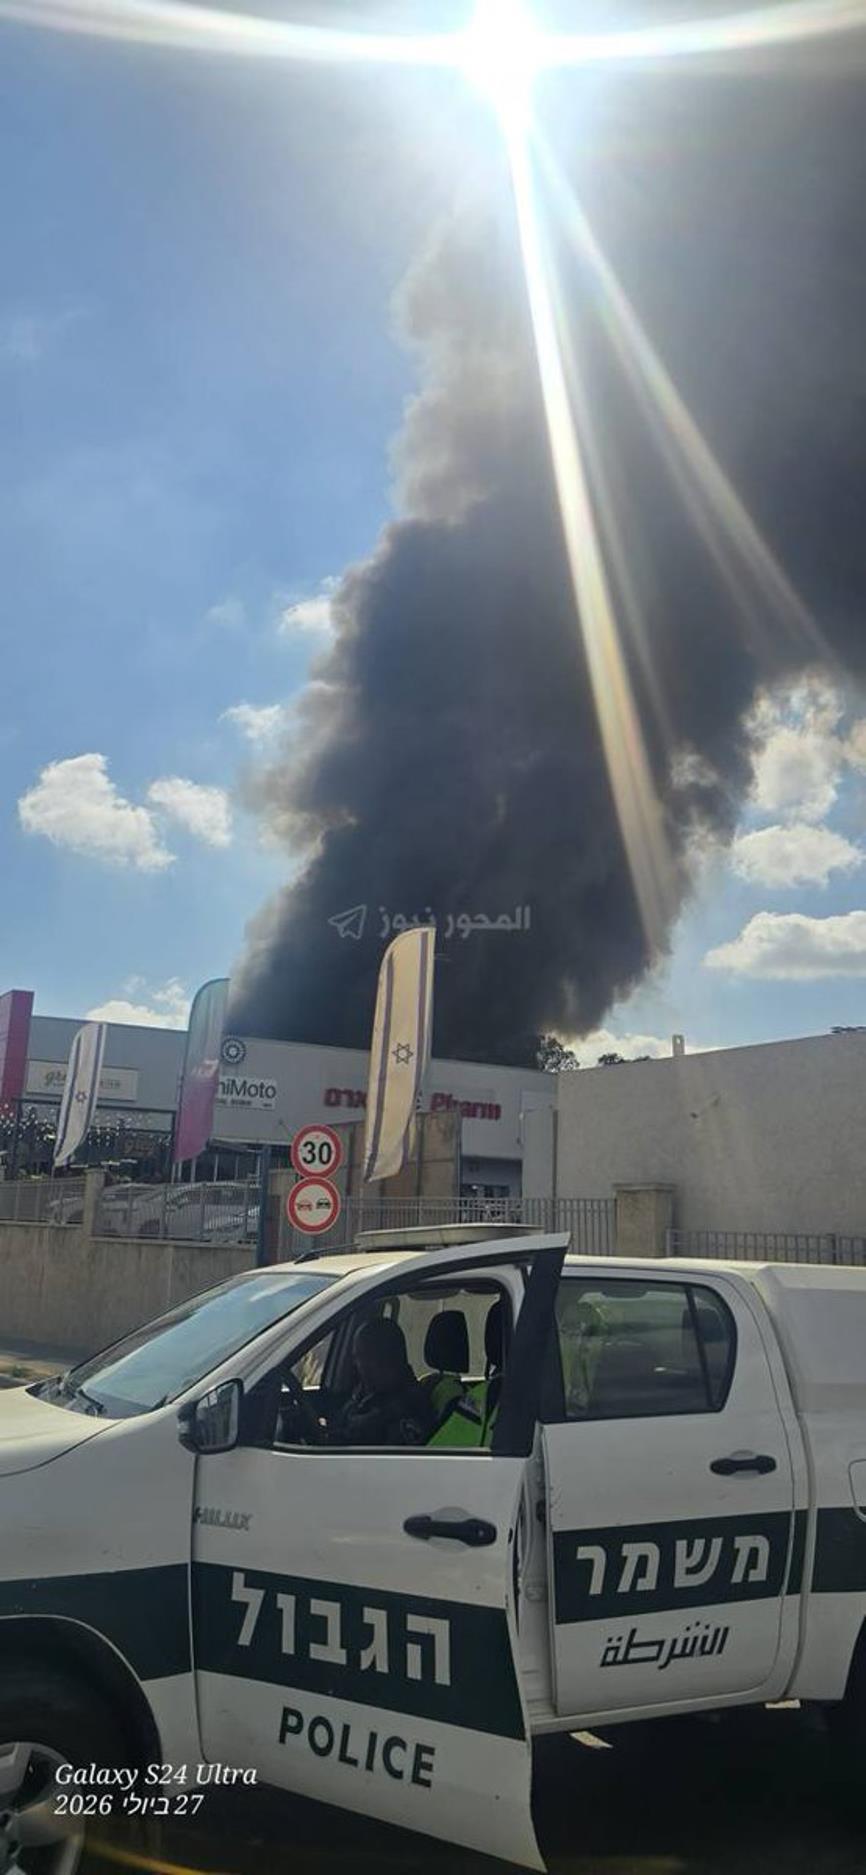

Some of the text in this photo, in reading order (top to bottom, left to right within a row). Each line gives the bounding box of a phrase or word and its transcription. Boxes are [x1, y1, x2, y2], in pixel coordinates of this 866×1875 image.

[302, 1141, 332, 1165] 30
[576, 1533, 771, 1596] משמר
[230, 1571, 452, 1687] הגבול
[599, 1620, 730, 1670] الشرطة
[278, 1706, 436, 1788] POLICE
